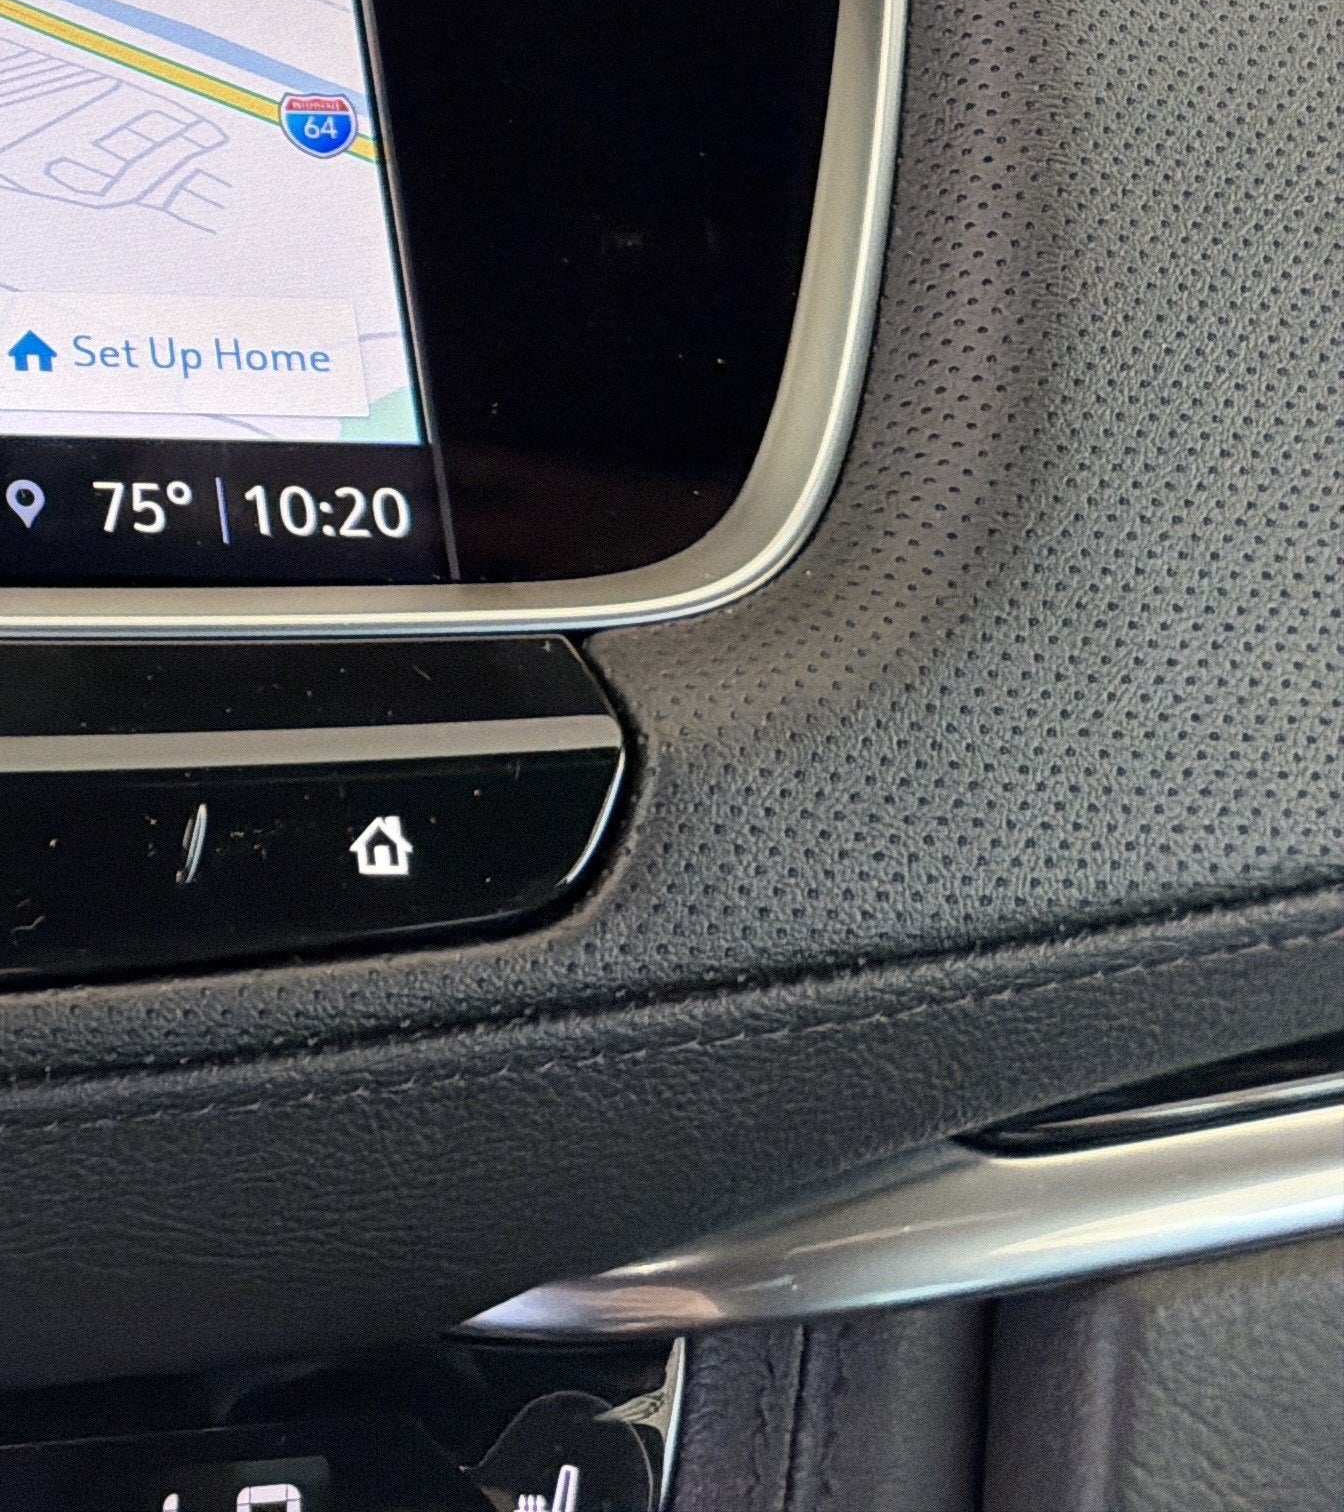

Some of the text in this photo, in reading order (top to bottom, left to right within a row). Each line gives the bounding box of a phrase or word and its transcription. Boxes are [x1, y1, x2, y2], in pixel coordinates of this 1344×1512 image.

[304, 115, 339, 140] 64
[72, 334, 331, 380] Set Up Home
[91, 480, 193, 534] 75°
[243, 483, 410, 540] 10:20
